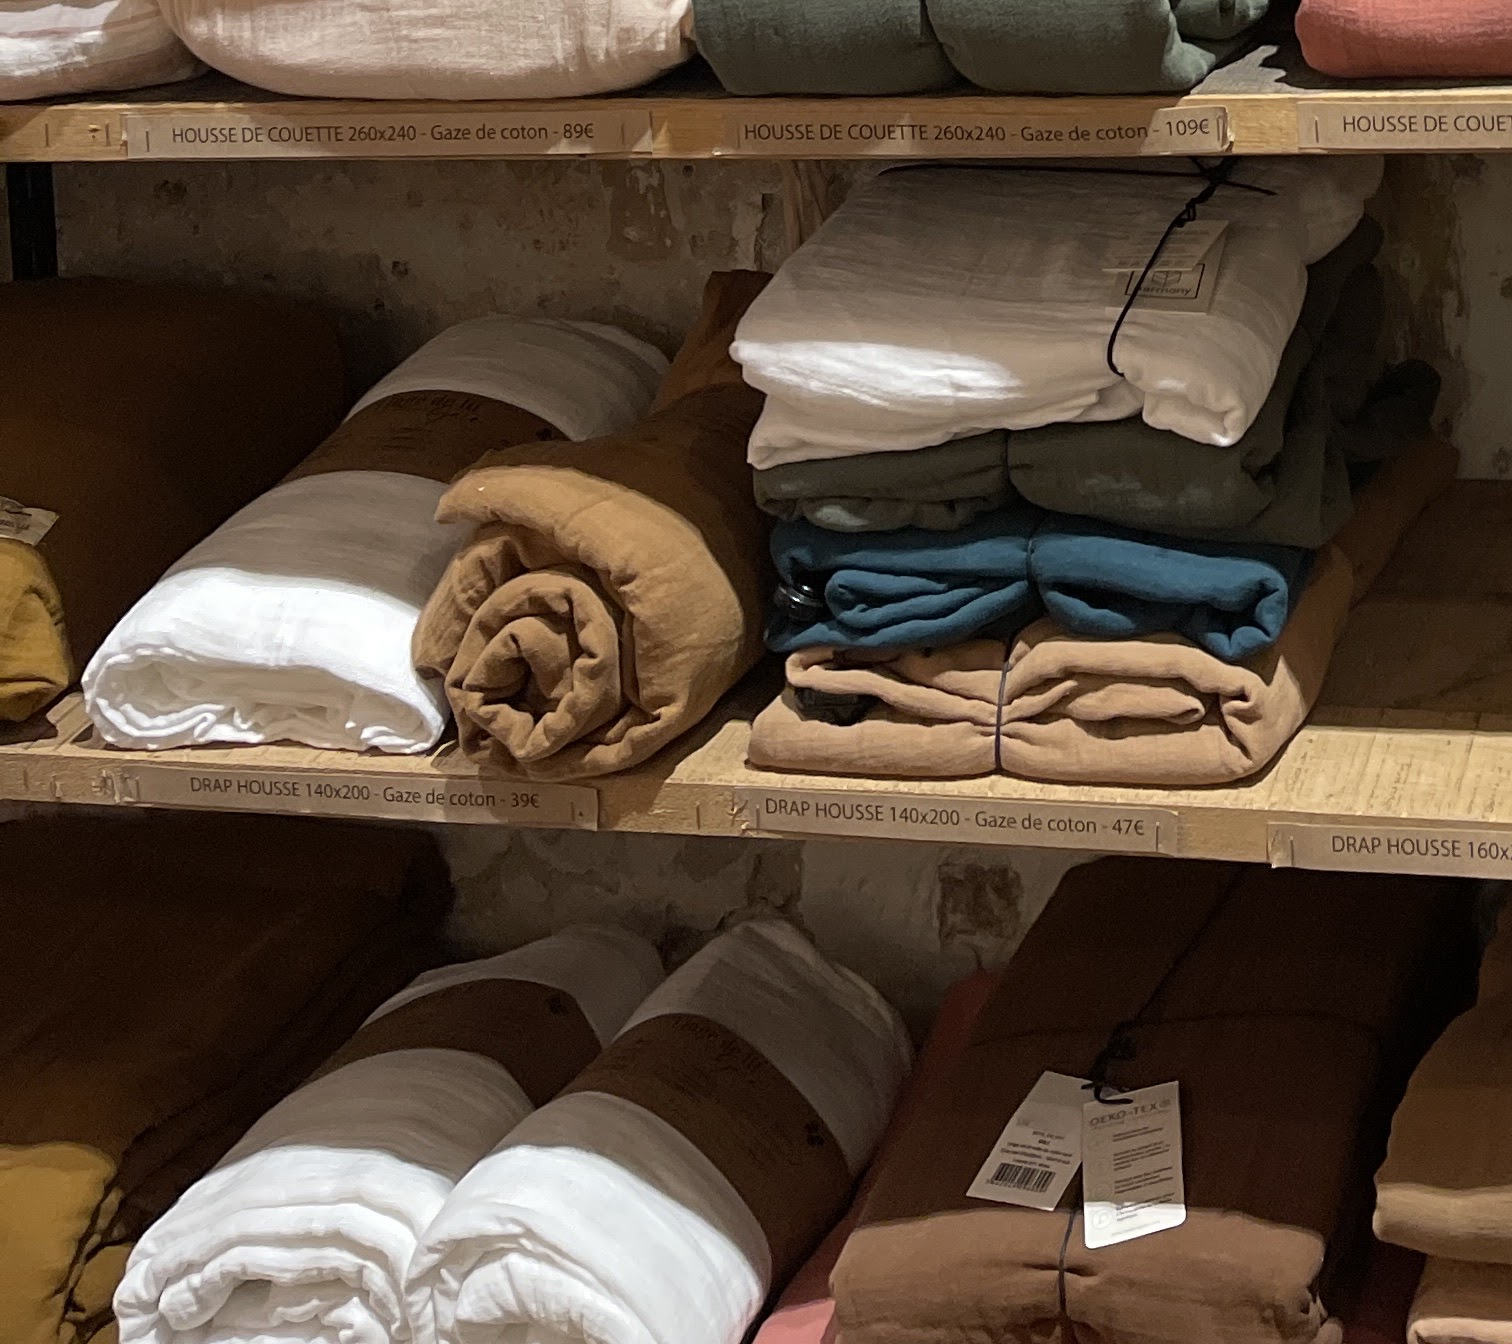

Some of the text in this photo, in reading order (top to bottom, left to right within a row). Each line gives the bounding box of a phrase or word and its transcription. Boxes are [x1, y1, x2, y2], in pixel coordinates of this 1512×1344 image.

[172, 127, 238, 144] HOUSSE
[241, 126, 263, 143] DE
[267, 125, 344, 143] COUETTE
[348, 124, 417, 142] 260x240
[430, 124, 471, 141] Gaze
[476, 123, 496, 140] de
[500, 125, 548, 140] coton
[563, 122, 594, 140] 89€
[744, 123, 815, 141] HOUSSE
[820, 123, 843, 141] DE
[848, 123, 929, 141] COUETTE
[933, 125, 1006, 141] 260x240
[1020, 125, 1063, 142] Gaze
[1068, 125, 1091, 142] de
[1096, 125, 1148, 141] coton
[1165, 118, 1210, 136] 109€
[1343, 115, 1418, 133] HOUSSE
[1423, 115, 1449, 133] DE
[1136, 285, 1192, 296] armony
[190, 776, 233, 793] DRAP
[236, 779, 301, 797] HOUSSE
[306, 782, 371, 801] 140x200
[383, 786, 422, 804] Gaze
[425, 787, 446, 806] de
[450, 791, 495, 807] coton
[511, 792, 540, 809] 39€
[765, 797, 811, 817] DRAP
[815, 802, 884, 822] HOUSSE
[890, 806, 960, 826] 140x200
[975, 810, 1017, 829] Gaze
[1021, 812, 1043, 831] de
[1047, 817, 1097, 834] coton
[1112, 818, 1145, 836] 47€
[1332, 835, 1381, 854] DRAP
[1386, 837, 1461, 858] HOUSSE
